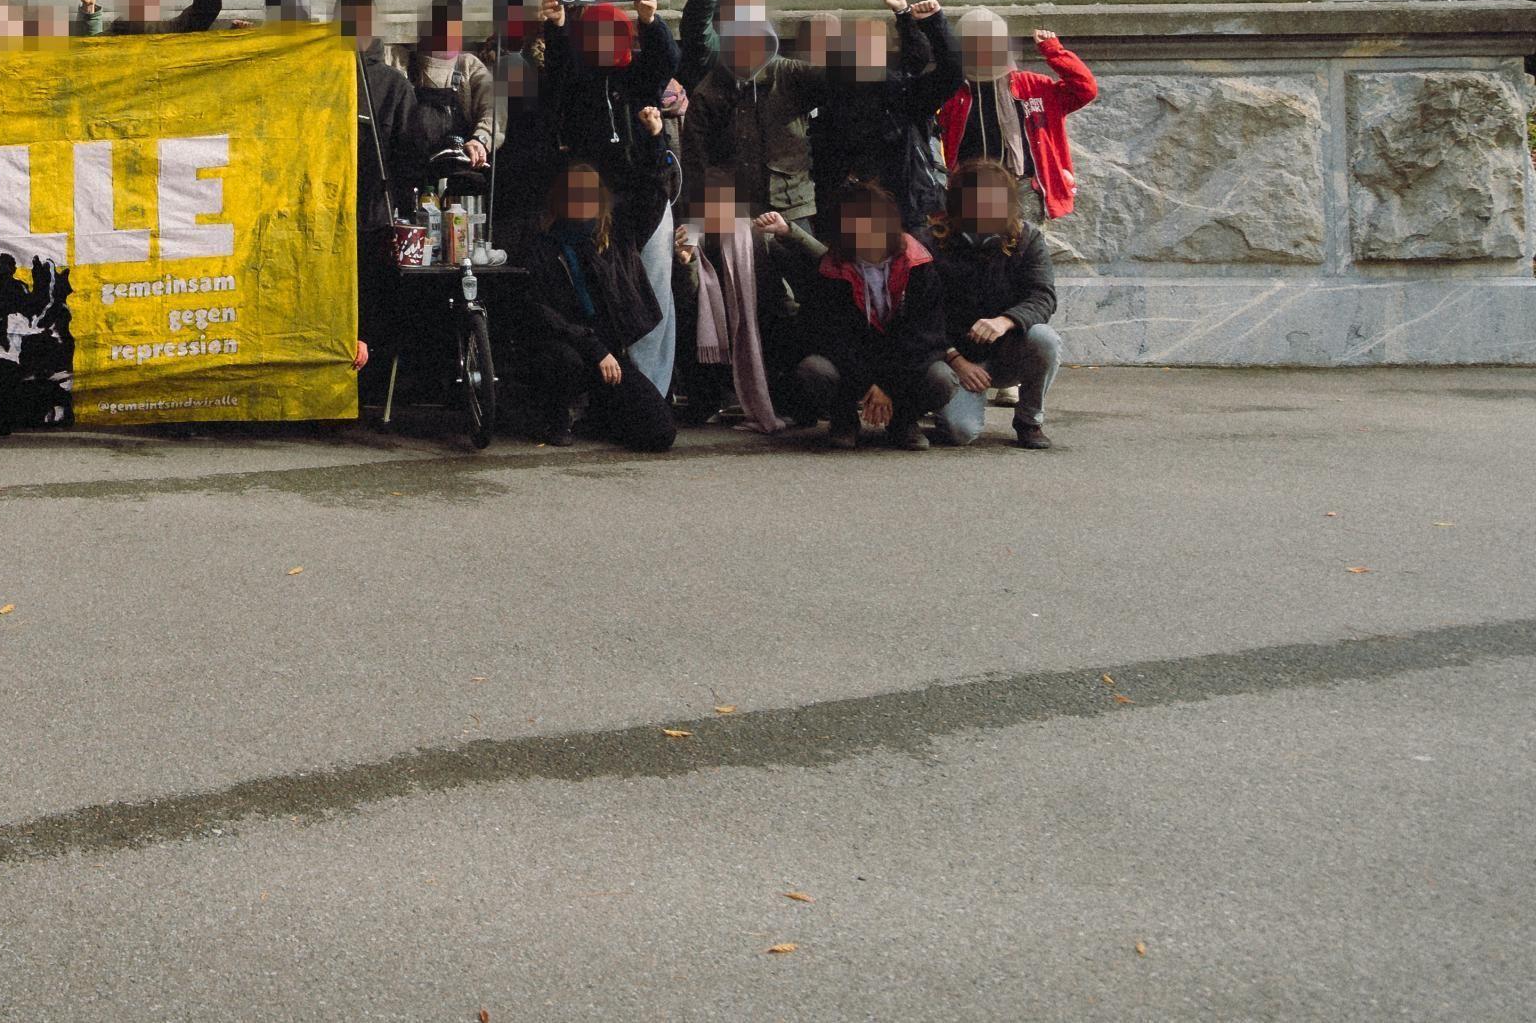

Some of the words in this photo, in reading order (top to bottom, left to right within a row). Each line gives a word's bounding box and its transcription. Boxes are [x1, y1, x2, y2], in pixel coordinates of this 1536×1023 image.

[100, 273, 236, 306] gemeinsam
[168, 306, 236, 332] gegen
[111, 333, 239, 365] repression
